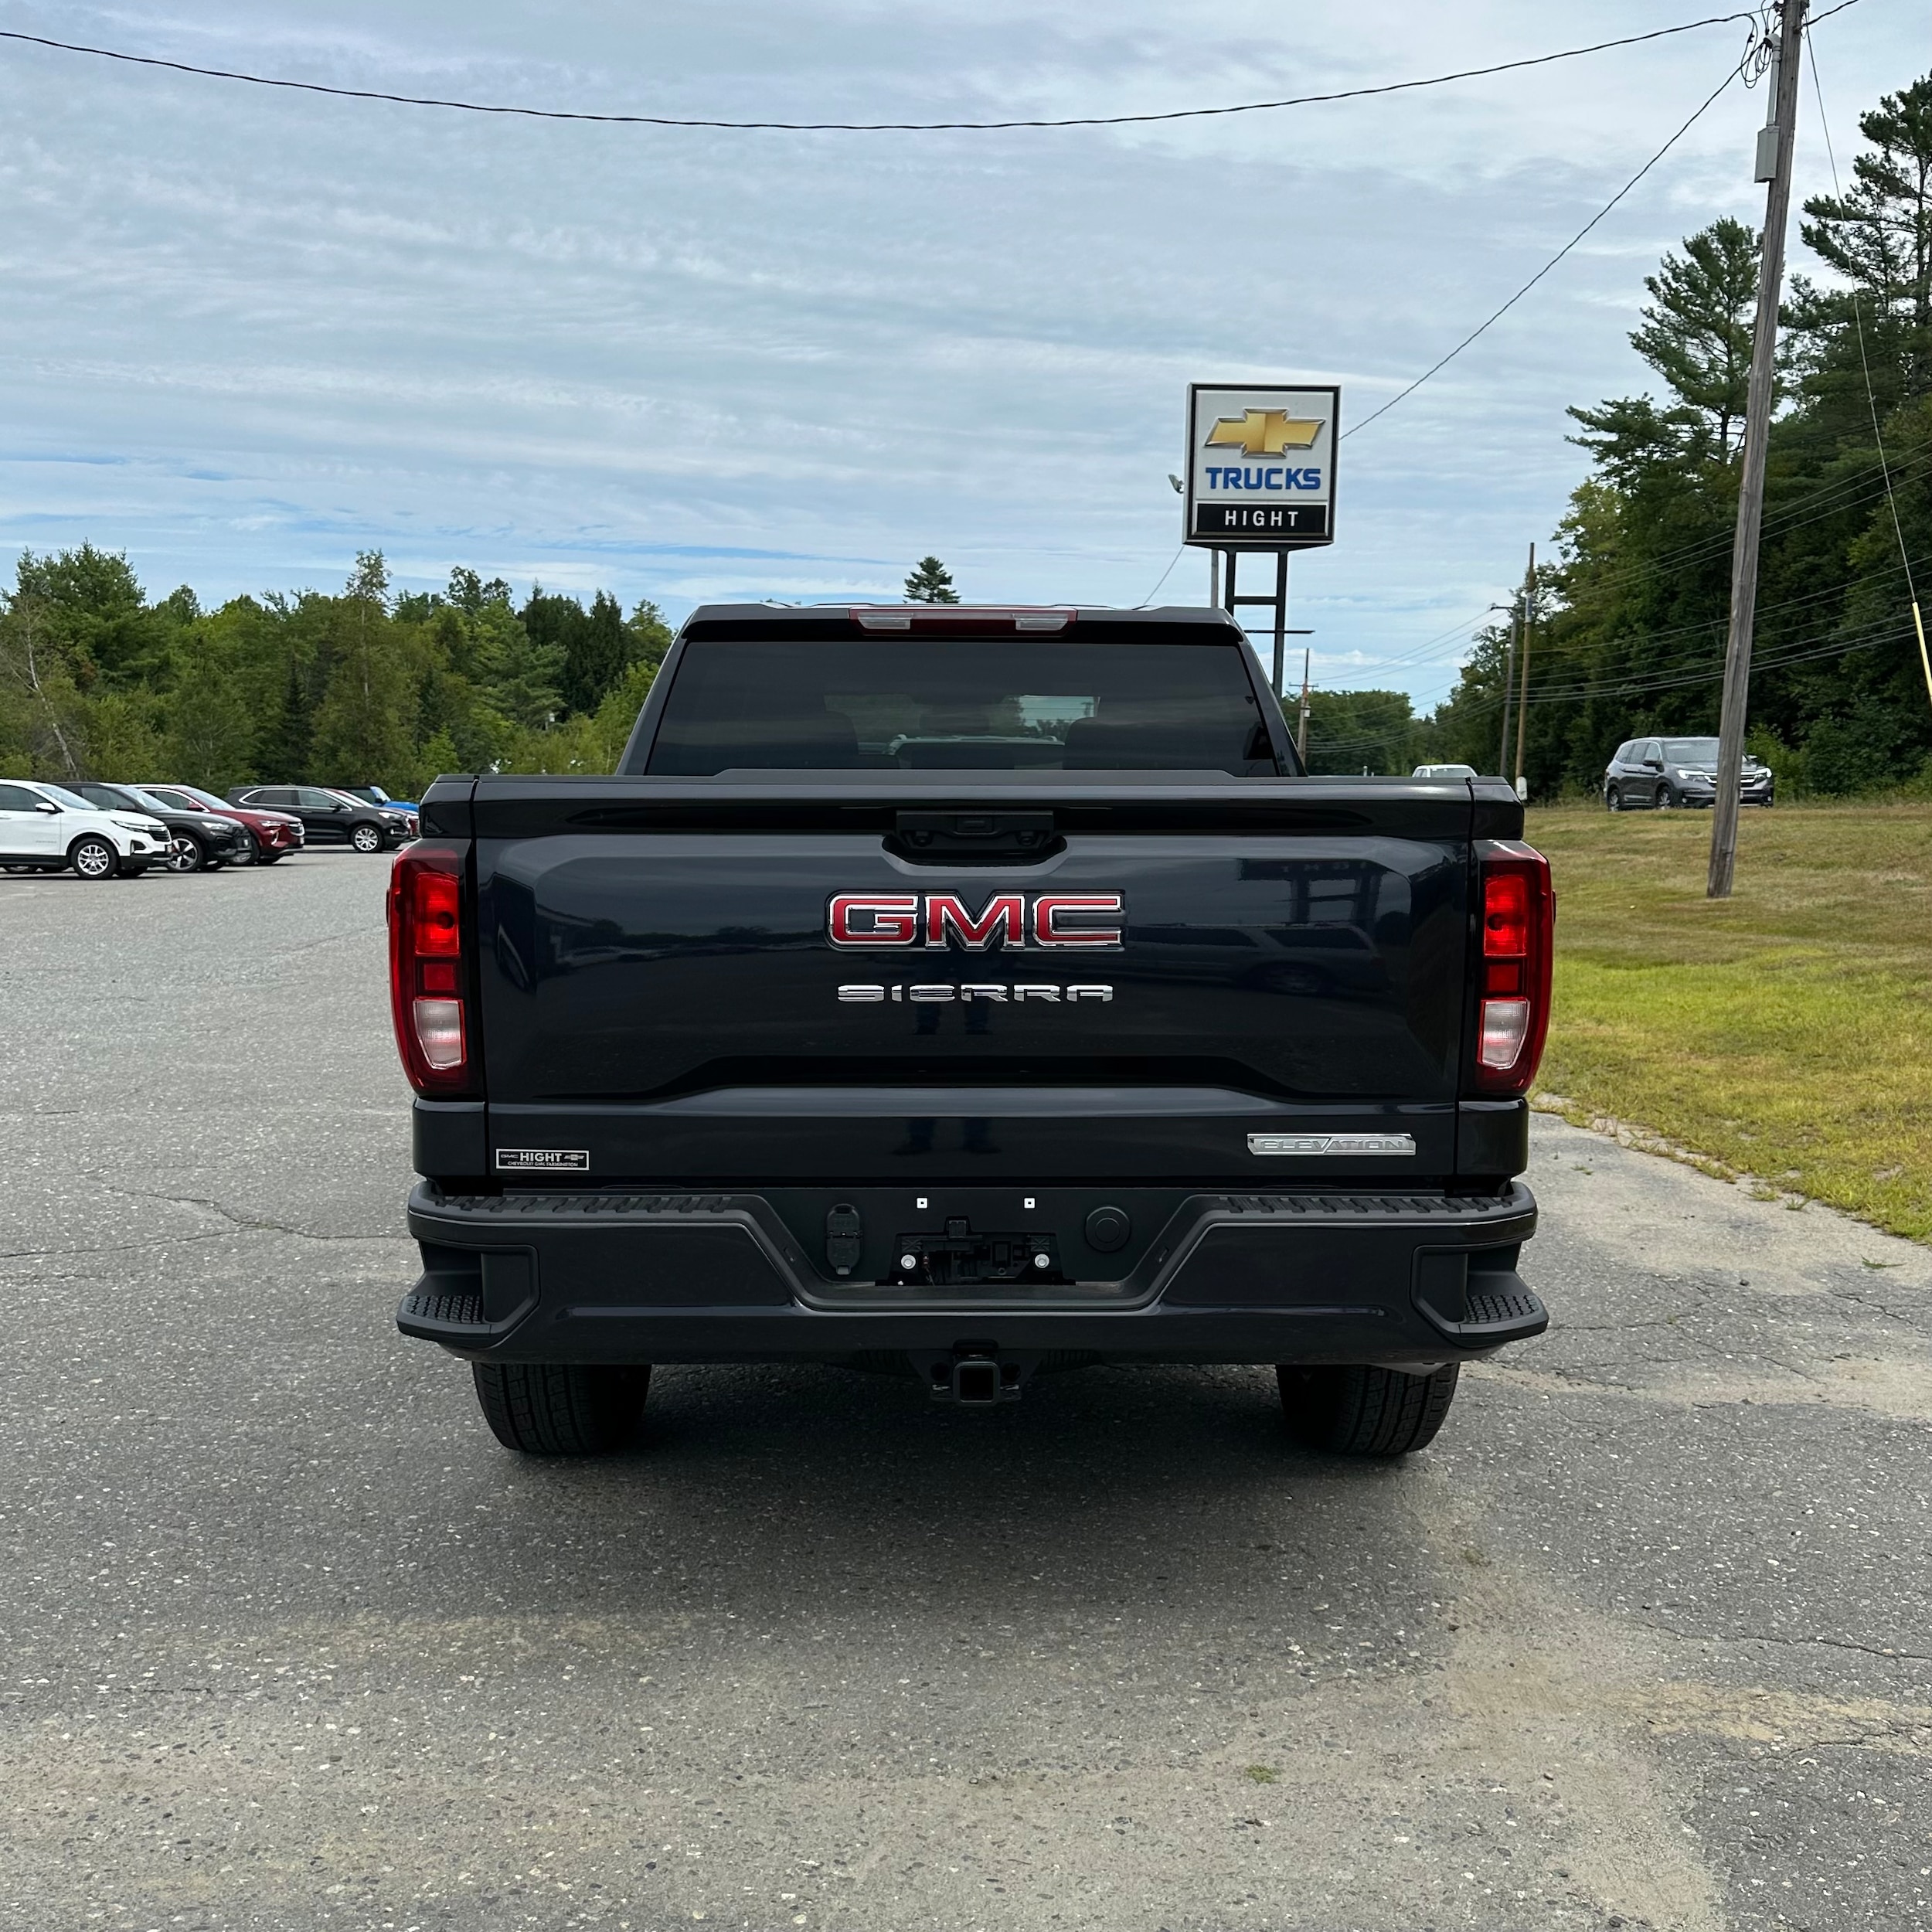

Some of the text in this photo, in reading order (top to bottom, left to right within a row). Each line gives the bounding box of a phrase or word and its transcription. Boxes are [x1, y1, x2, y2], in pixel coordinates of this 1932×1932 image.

[1206, 467, 1321, 490] TRUCKS
[1224, 510, 1298, 526] HIGHT
[829, 895, 1123, 949] GMC
[838, 985, 1114, 1002] SIERRA
[1260, 1138, 1406, 1151] ELEVATION
[520, 1153, 562, 1162] HIGHT
